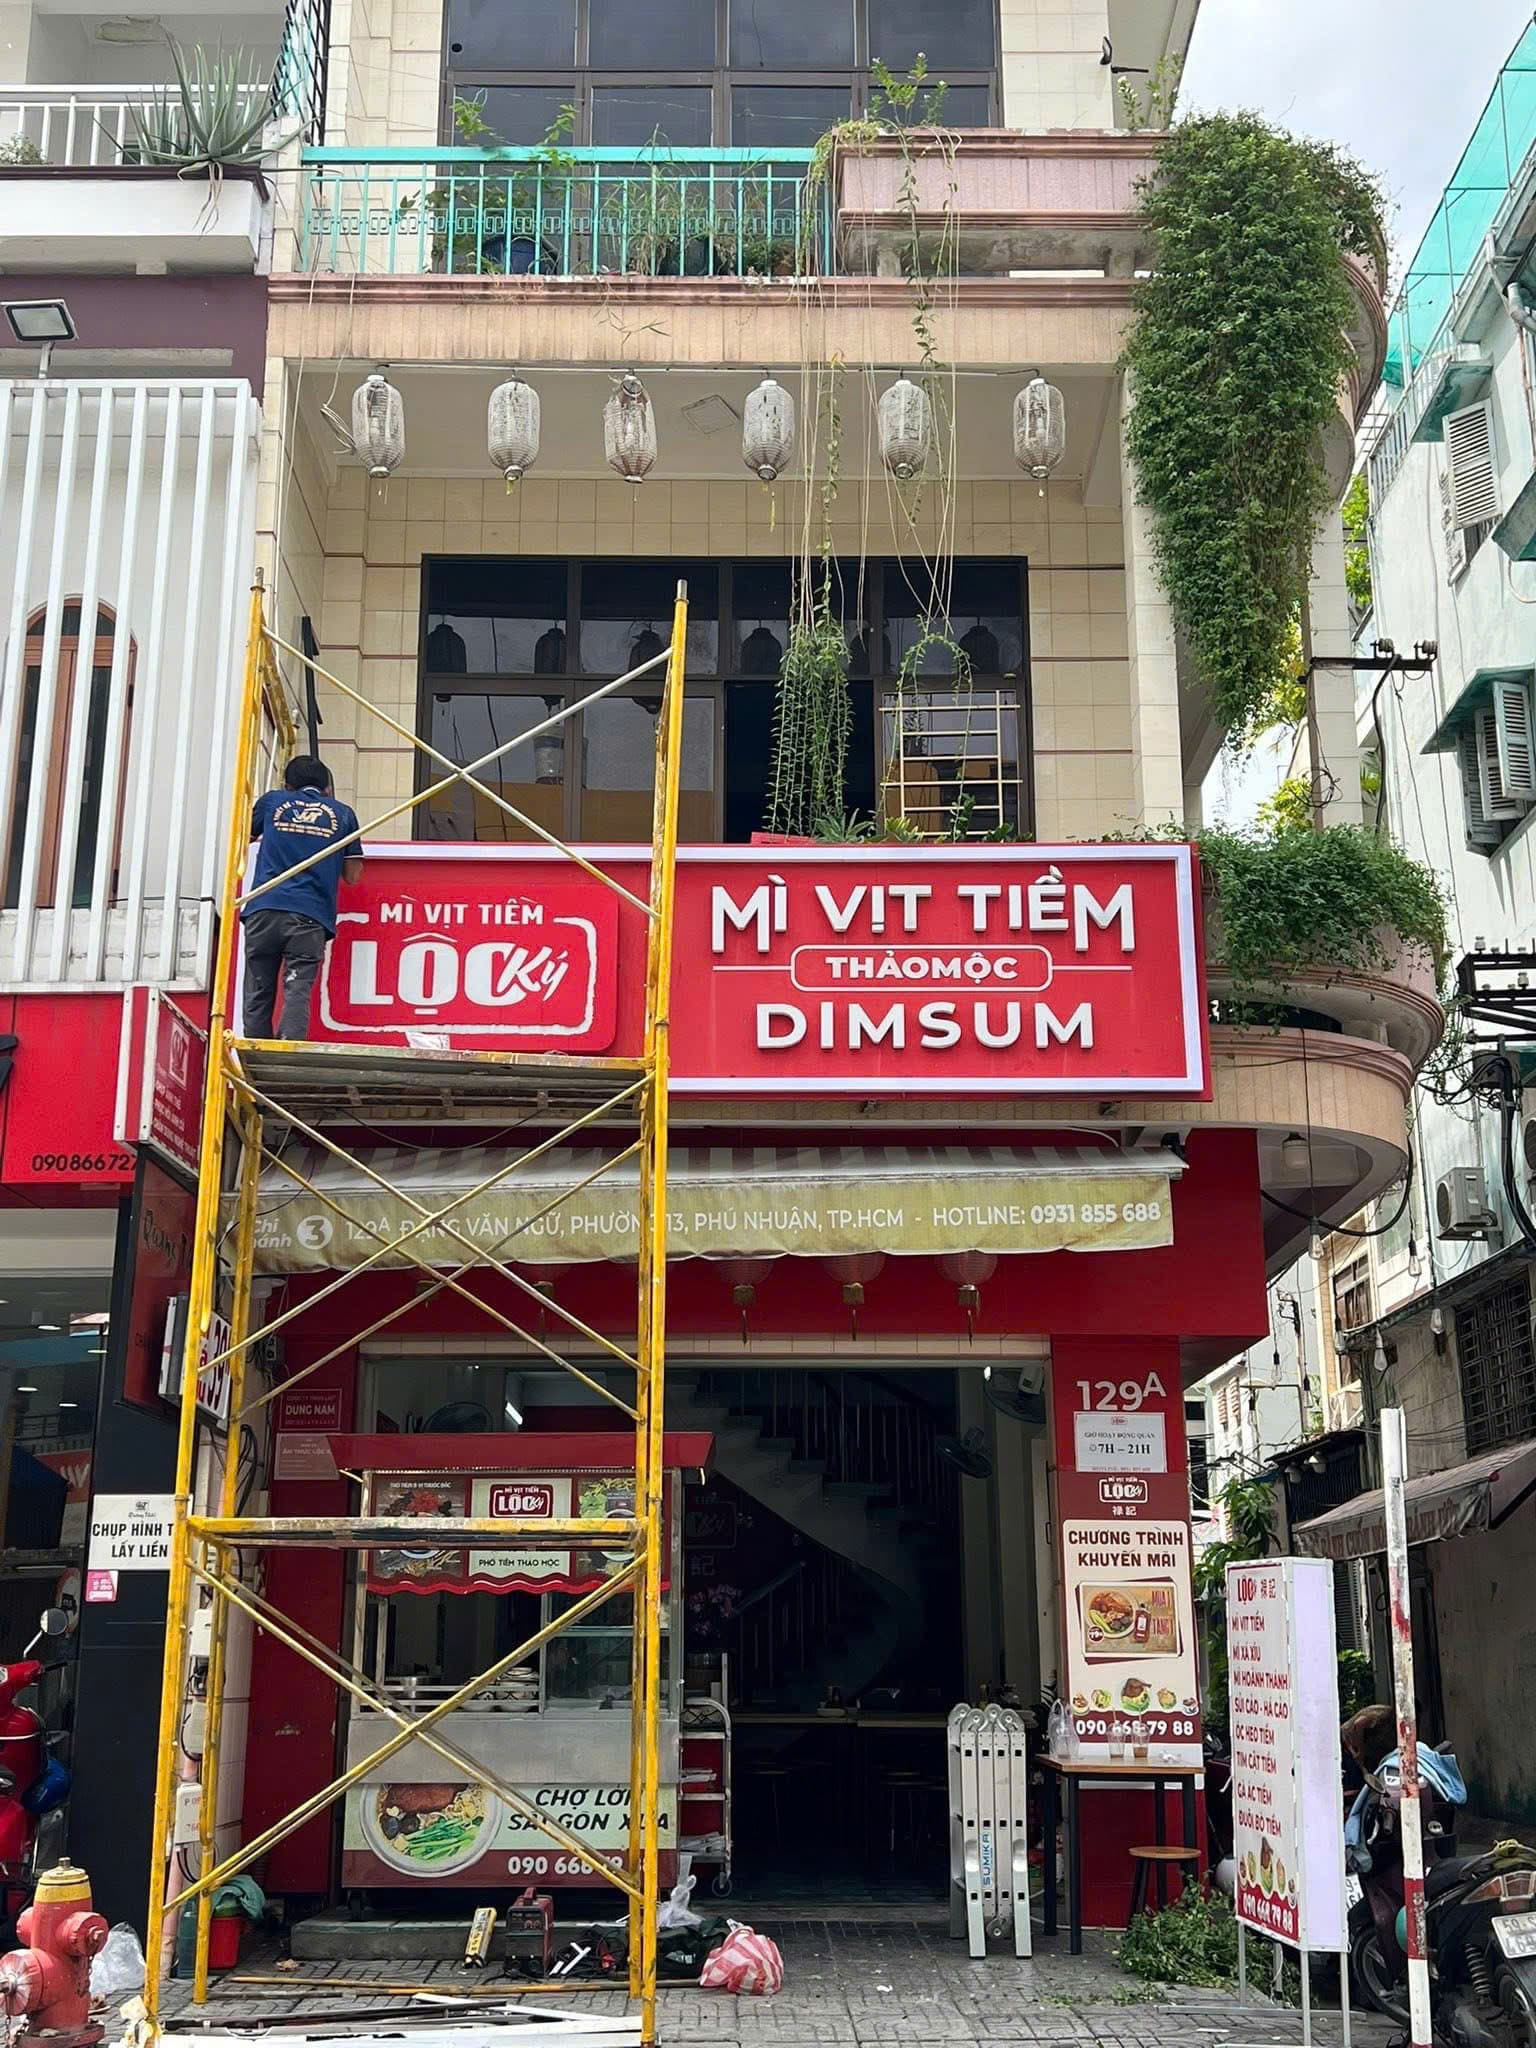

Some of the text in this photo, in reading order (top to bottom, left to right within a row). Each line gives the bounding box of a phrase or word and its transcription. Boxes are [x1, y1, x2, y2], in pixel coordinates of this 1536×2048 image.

[380, 894, 545, 929] MÌ VỊT TIỀM
[712, 864, 1136, 953] MÌ VỊT TIỀM
[350, 931, 527, 1015] LỘC
[755, 1001, 1095, 1049] DIMSUM
[466, 1214, 509, 1237] VĂN
[695, 1209, 735, 1231] PHÚ
[744, 1207, 822, 1234] NHUẬN,
[827, 1208, 903, 1229] TP.HCM
[933, 1205, 1025, 1226] HOTLINE:
[1030, 1203, 1075, 1225] 0931
[1080, 1203, 1117, 1223] 855
[1121, 1202, 1161, 1222] 688
[1076, 1371, 1167, 1411] 129A
[1098, 1443, 1114, 1454] 7H
[1128, 1443, 1151, 1454] 21H
[92, 1522, 127, 1540] CHỤP
[131, 1520, 162, 1537] HÌNH
[1068, 1526, 1184, 1546] CHƯƠNG TRÌNH
[111, 1539, 135, 1558] LẤY
[1077, 1549, 1176, 1568] KHUYẾN MÃI
[1076, 1720, 1106, 1735] 090
[1172, 1720, 1194, 1735] 88
[536, 1788, 589, 1810] CHỢ
[508, 1856, 548, 1875] 090
[982, 1833, 991, 1886] SUMIKA
